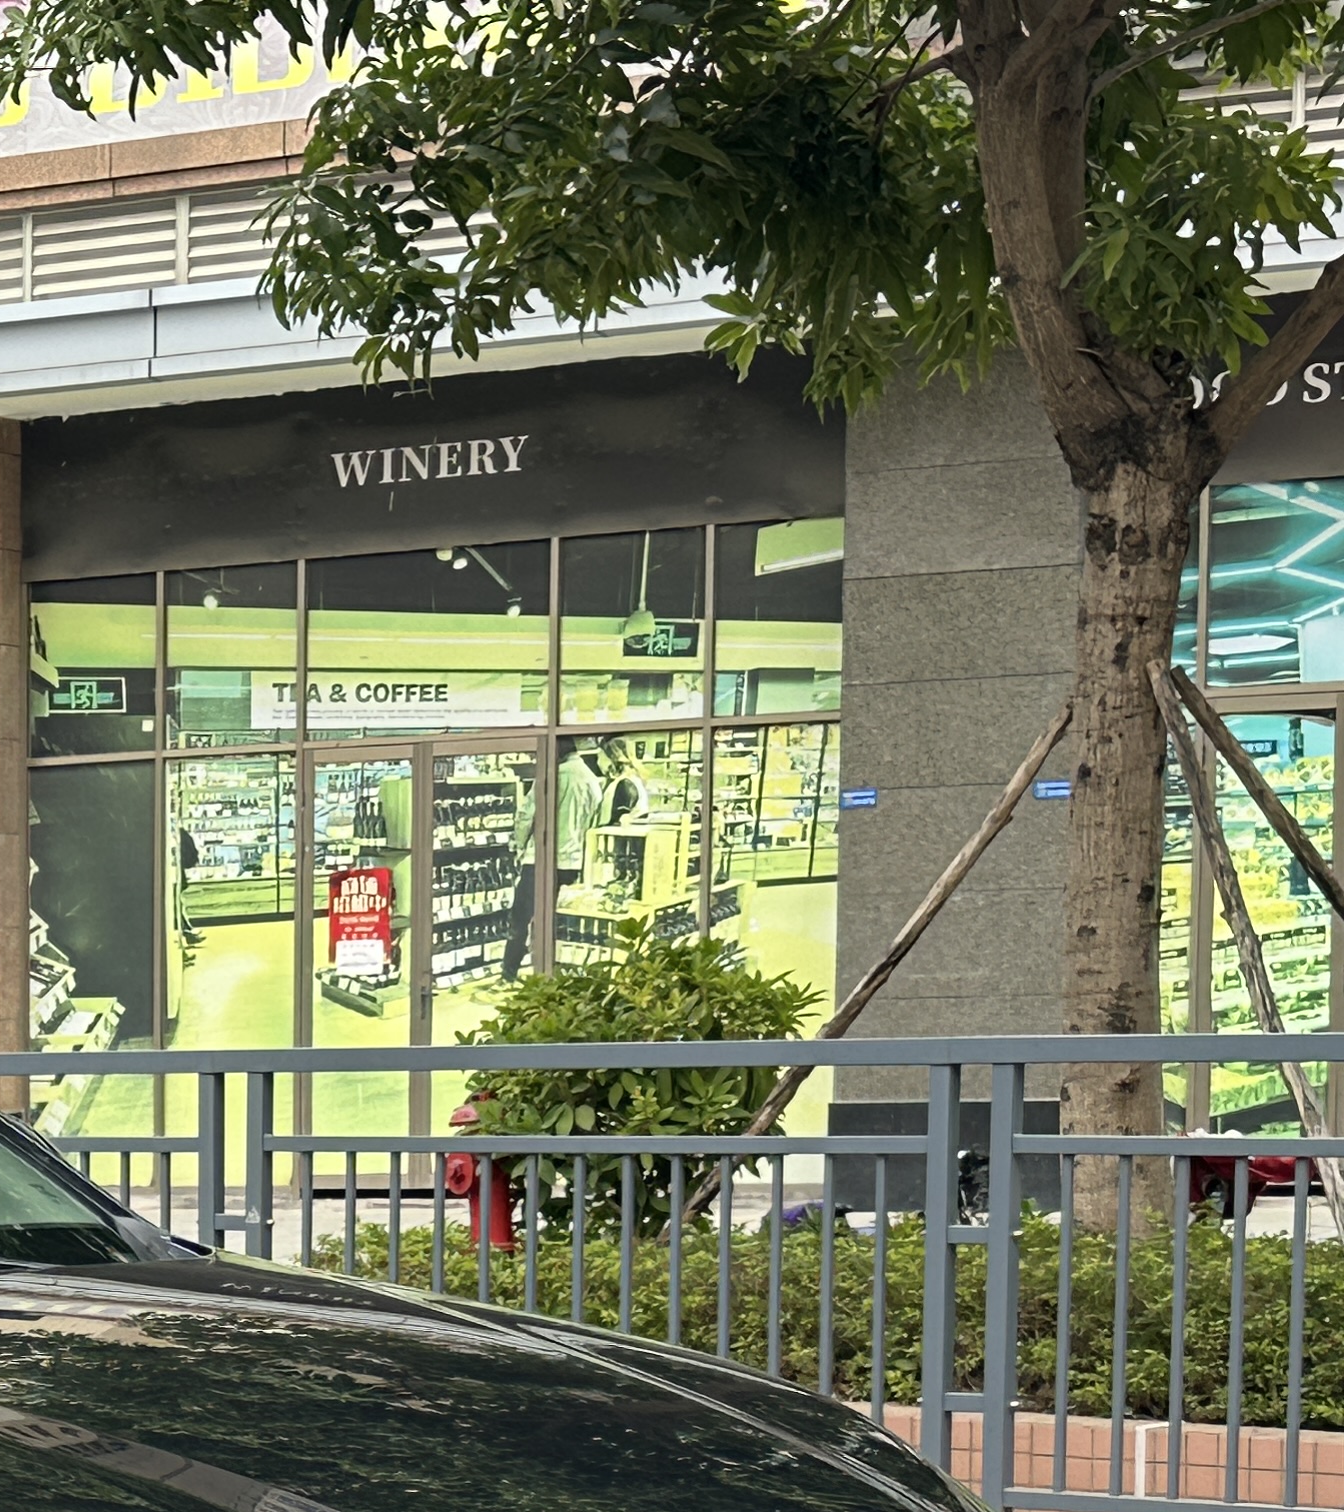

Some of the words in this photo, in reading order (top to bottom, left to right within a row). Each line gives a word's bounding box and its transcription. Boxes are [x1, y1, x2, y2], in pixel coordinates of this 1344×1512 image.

[330, 435, 529, 487] WINERY
[329, 683, 347, 703] &
[355, 682, 449, 703] COFFEE
